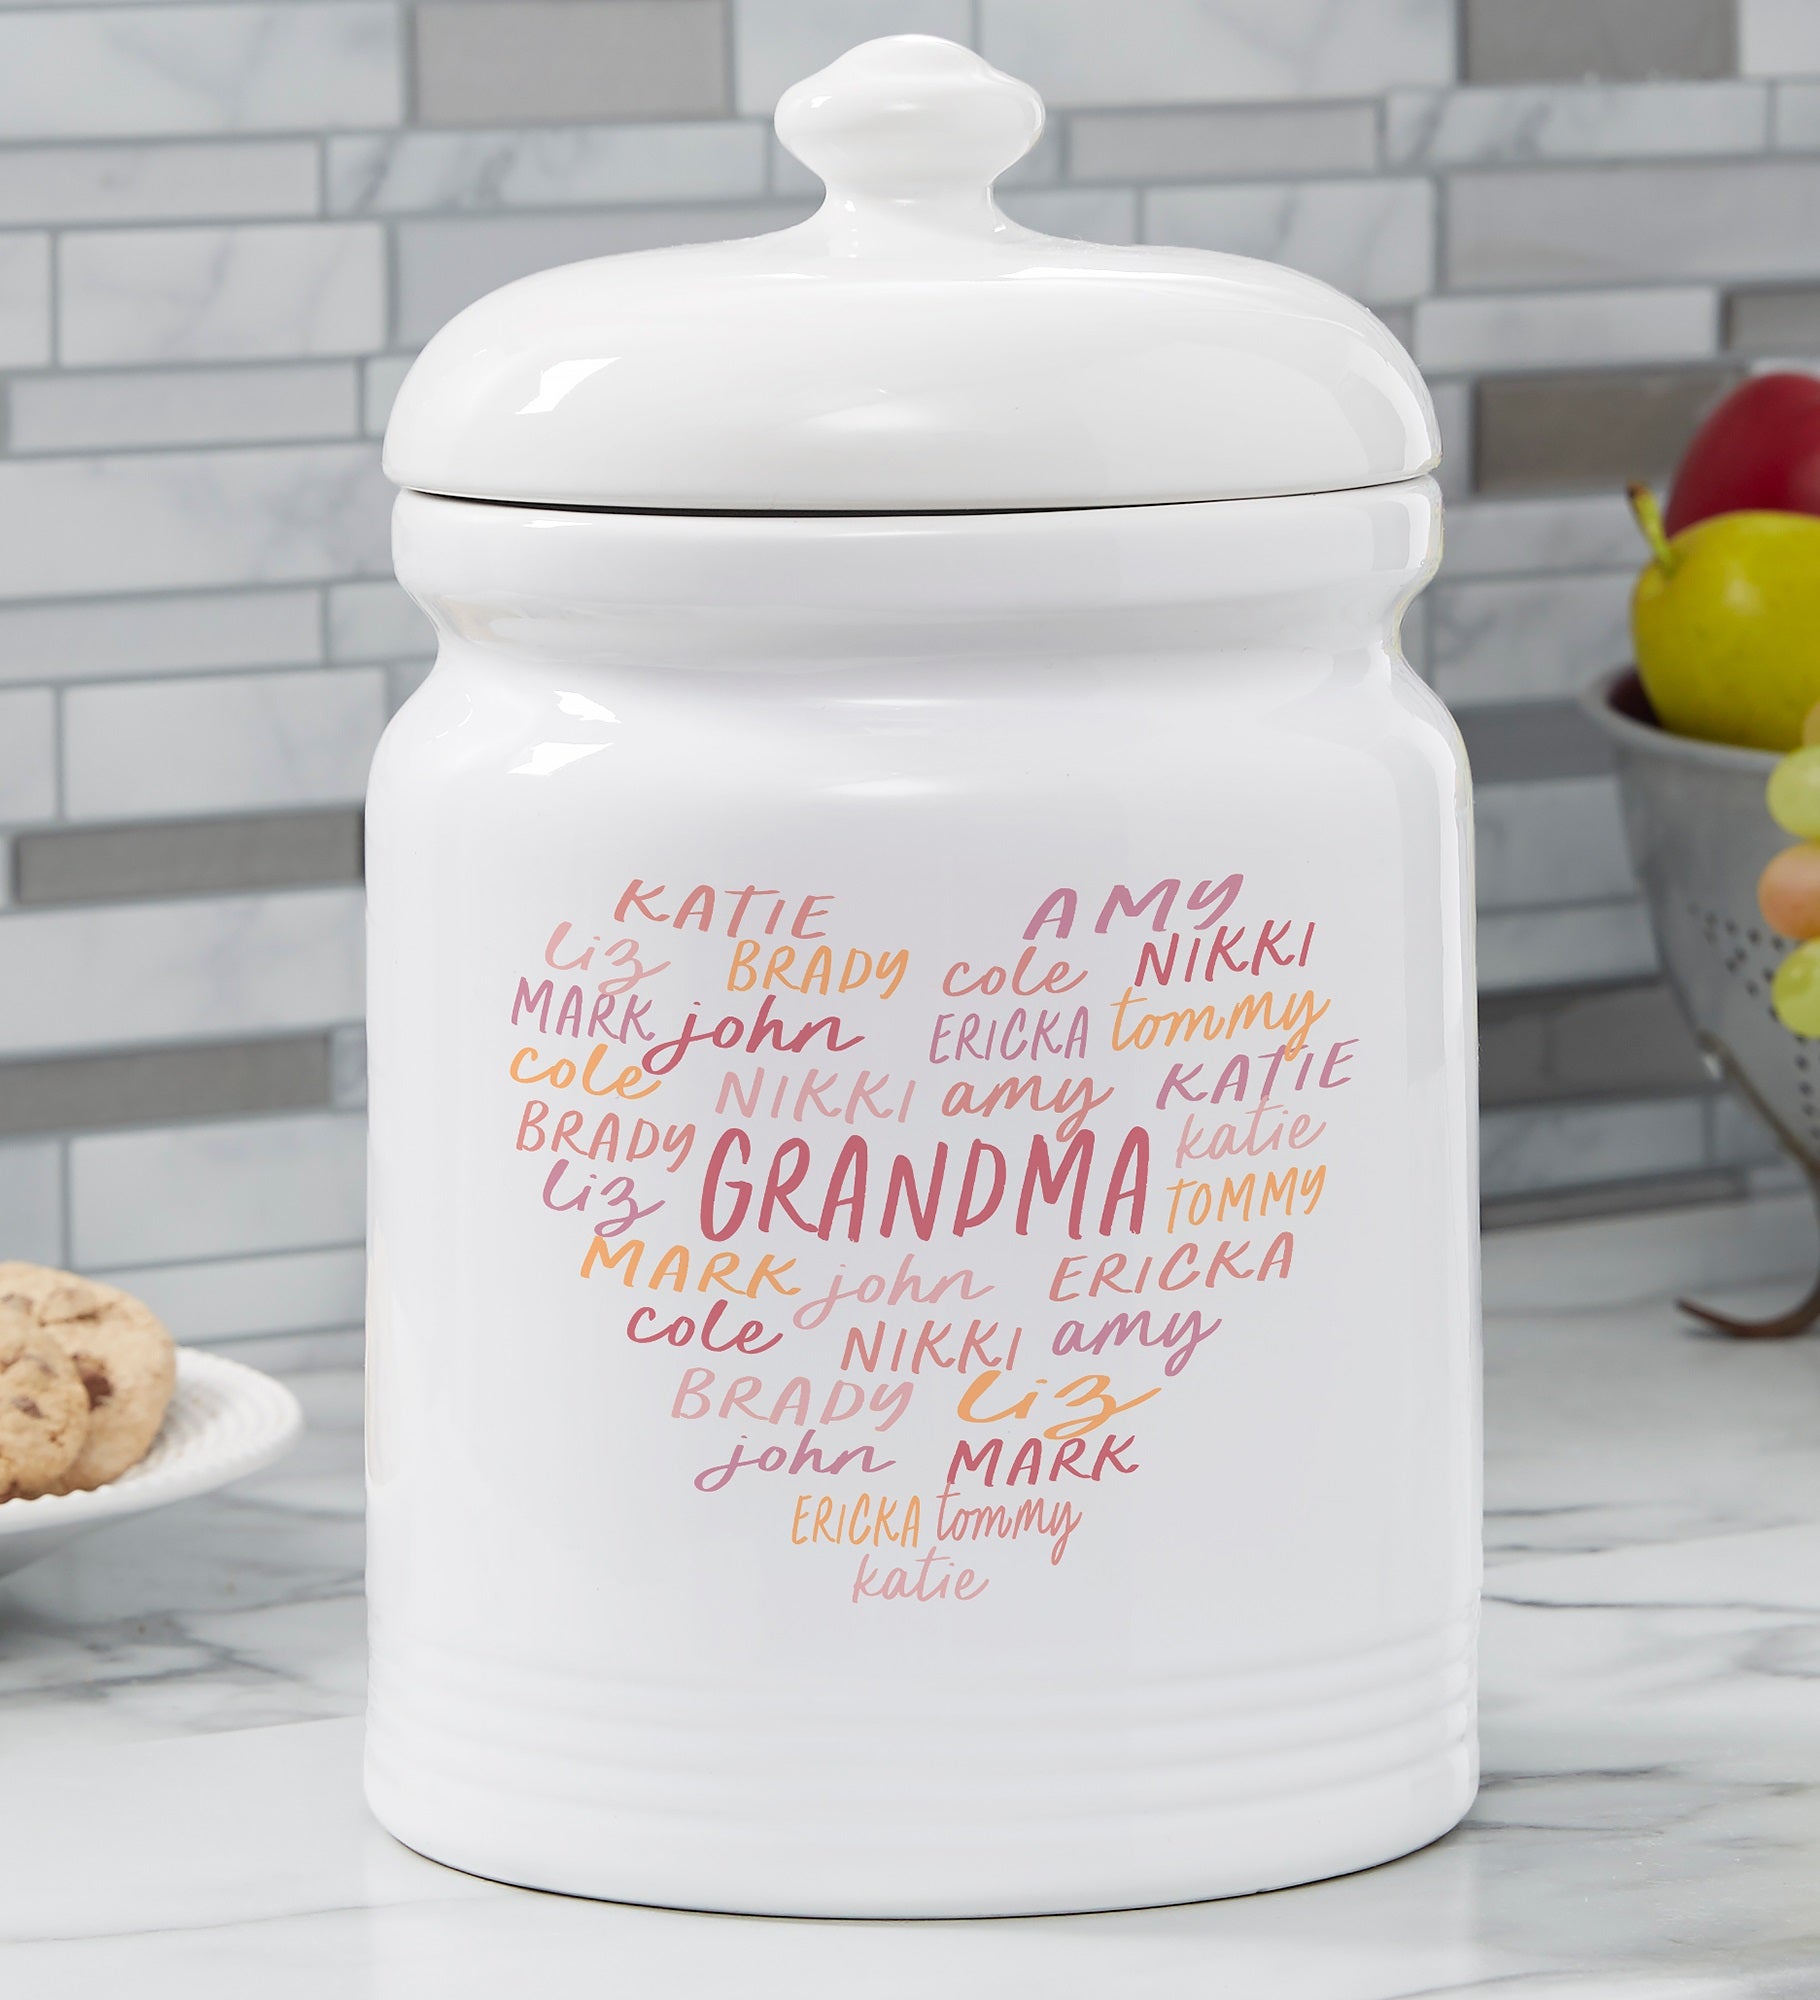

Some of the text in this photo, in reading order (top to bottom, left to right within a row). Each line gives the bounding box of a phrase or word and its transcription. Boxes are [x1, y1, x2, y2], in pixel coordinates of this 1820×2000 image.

[613, 879, 836, 940] KATIE
[1022, 873, 1244, 941] AMY
[726, 938, 910, 1001] BRADY
[941, 945, 1089, 997] cole
[1133, 919, 1316, 988] NIKKI
[510, 976, 1331, 1076] MARK john ERICKA tommy
[508, 1038, 1360, 1143] cole NIKKI amy KATIE
[515, 1094, 1327, 1173] BRADY katie
[699, 1125, 1150, 1243] GRANDMA
[1165, 1164, 1327, 1235] TOMMY
[579, 1231, 1294, 1330] MARK john ERICKA
[625, 1298, 1223, 1377] cole NIKKI amy
[671, 1367, 915, 1432] BRADY
[693, 1429, 1140, 1493] john MARK
[790, 1481, 1083, 1566] ERICKA tommy
[852, 1546, 990, 1603] katie
